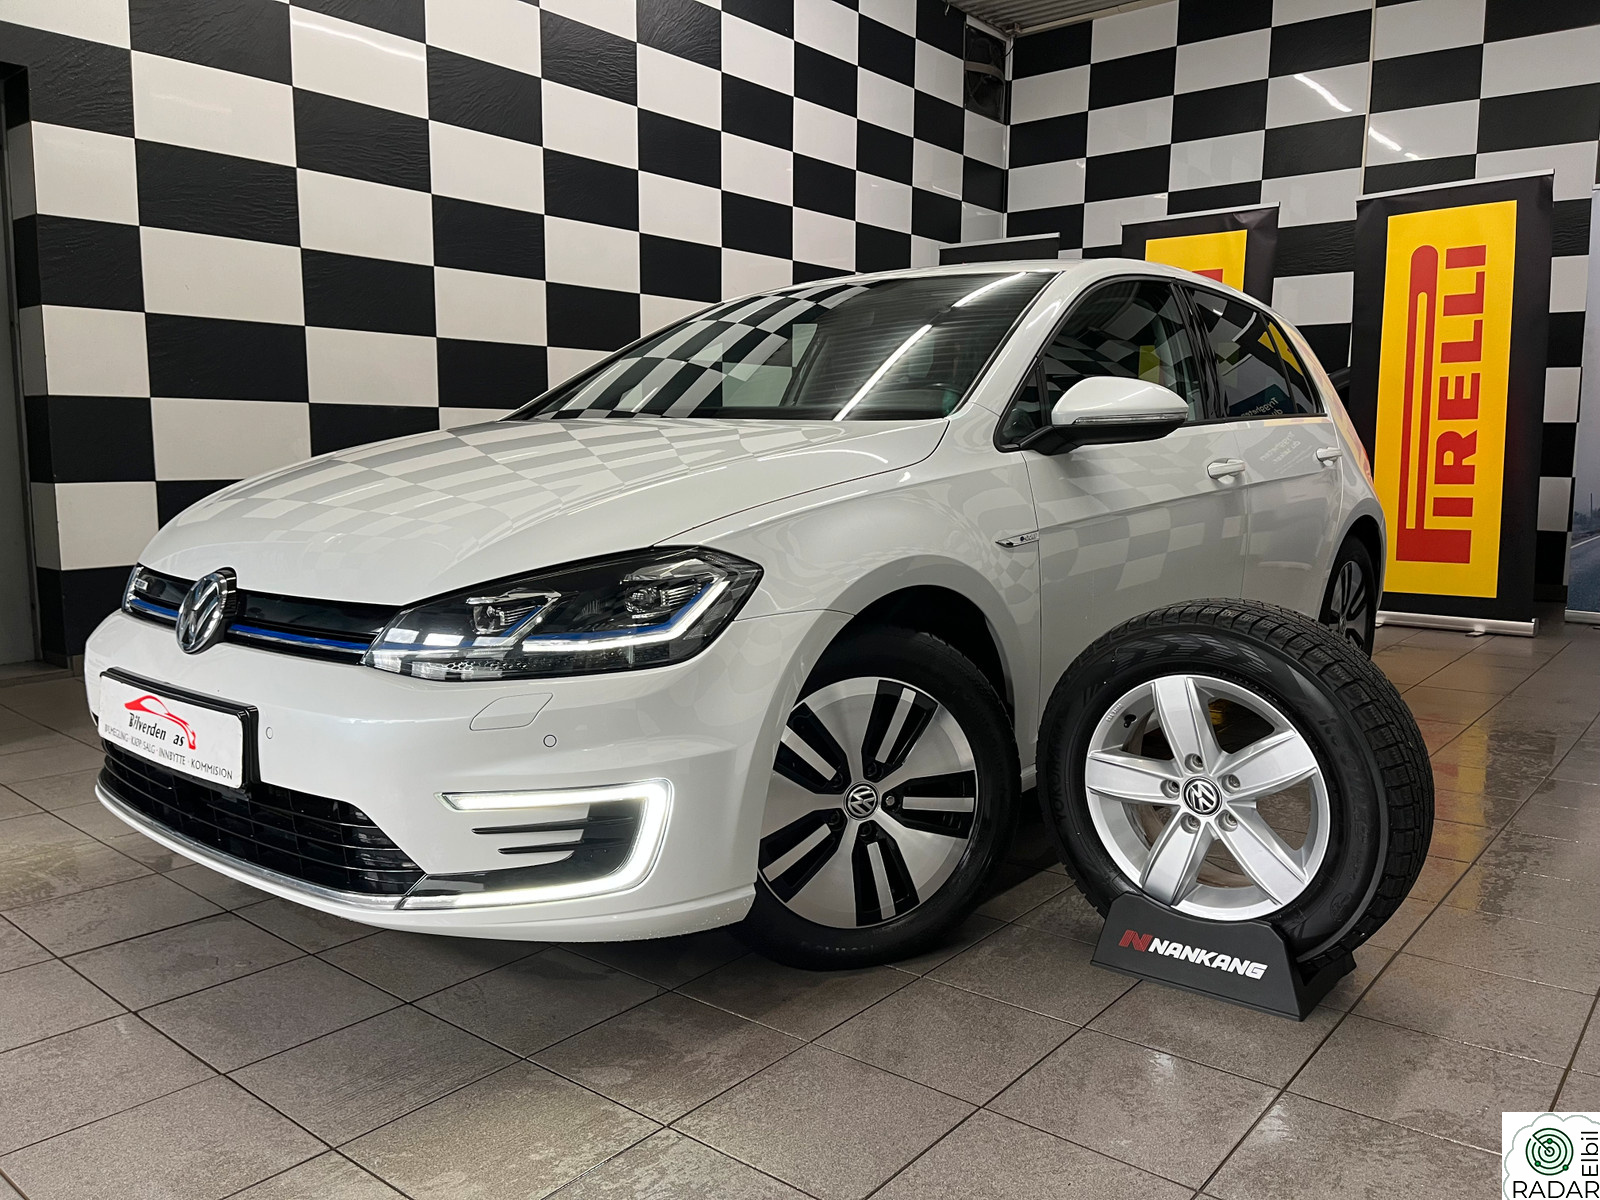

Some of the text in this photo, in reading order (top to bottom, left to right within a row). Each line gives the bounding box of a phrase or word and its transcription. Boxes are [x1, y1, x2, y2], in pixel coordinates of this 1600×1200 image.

[1396, 244, 1487, 564] PIRELLI
[128, 712, 185, 747] Bilverden as
[158, 747, 186, 766] INNBYTTE
[191, 758, 233, 780] KOMMISION
[1148, 937, 1269, 980] NANKANG
